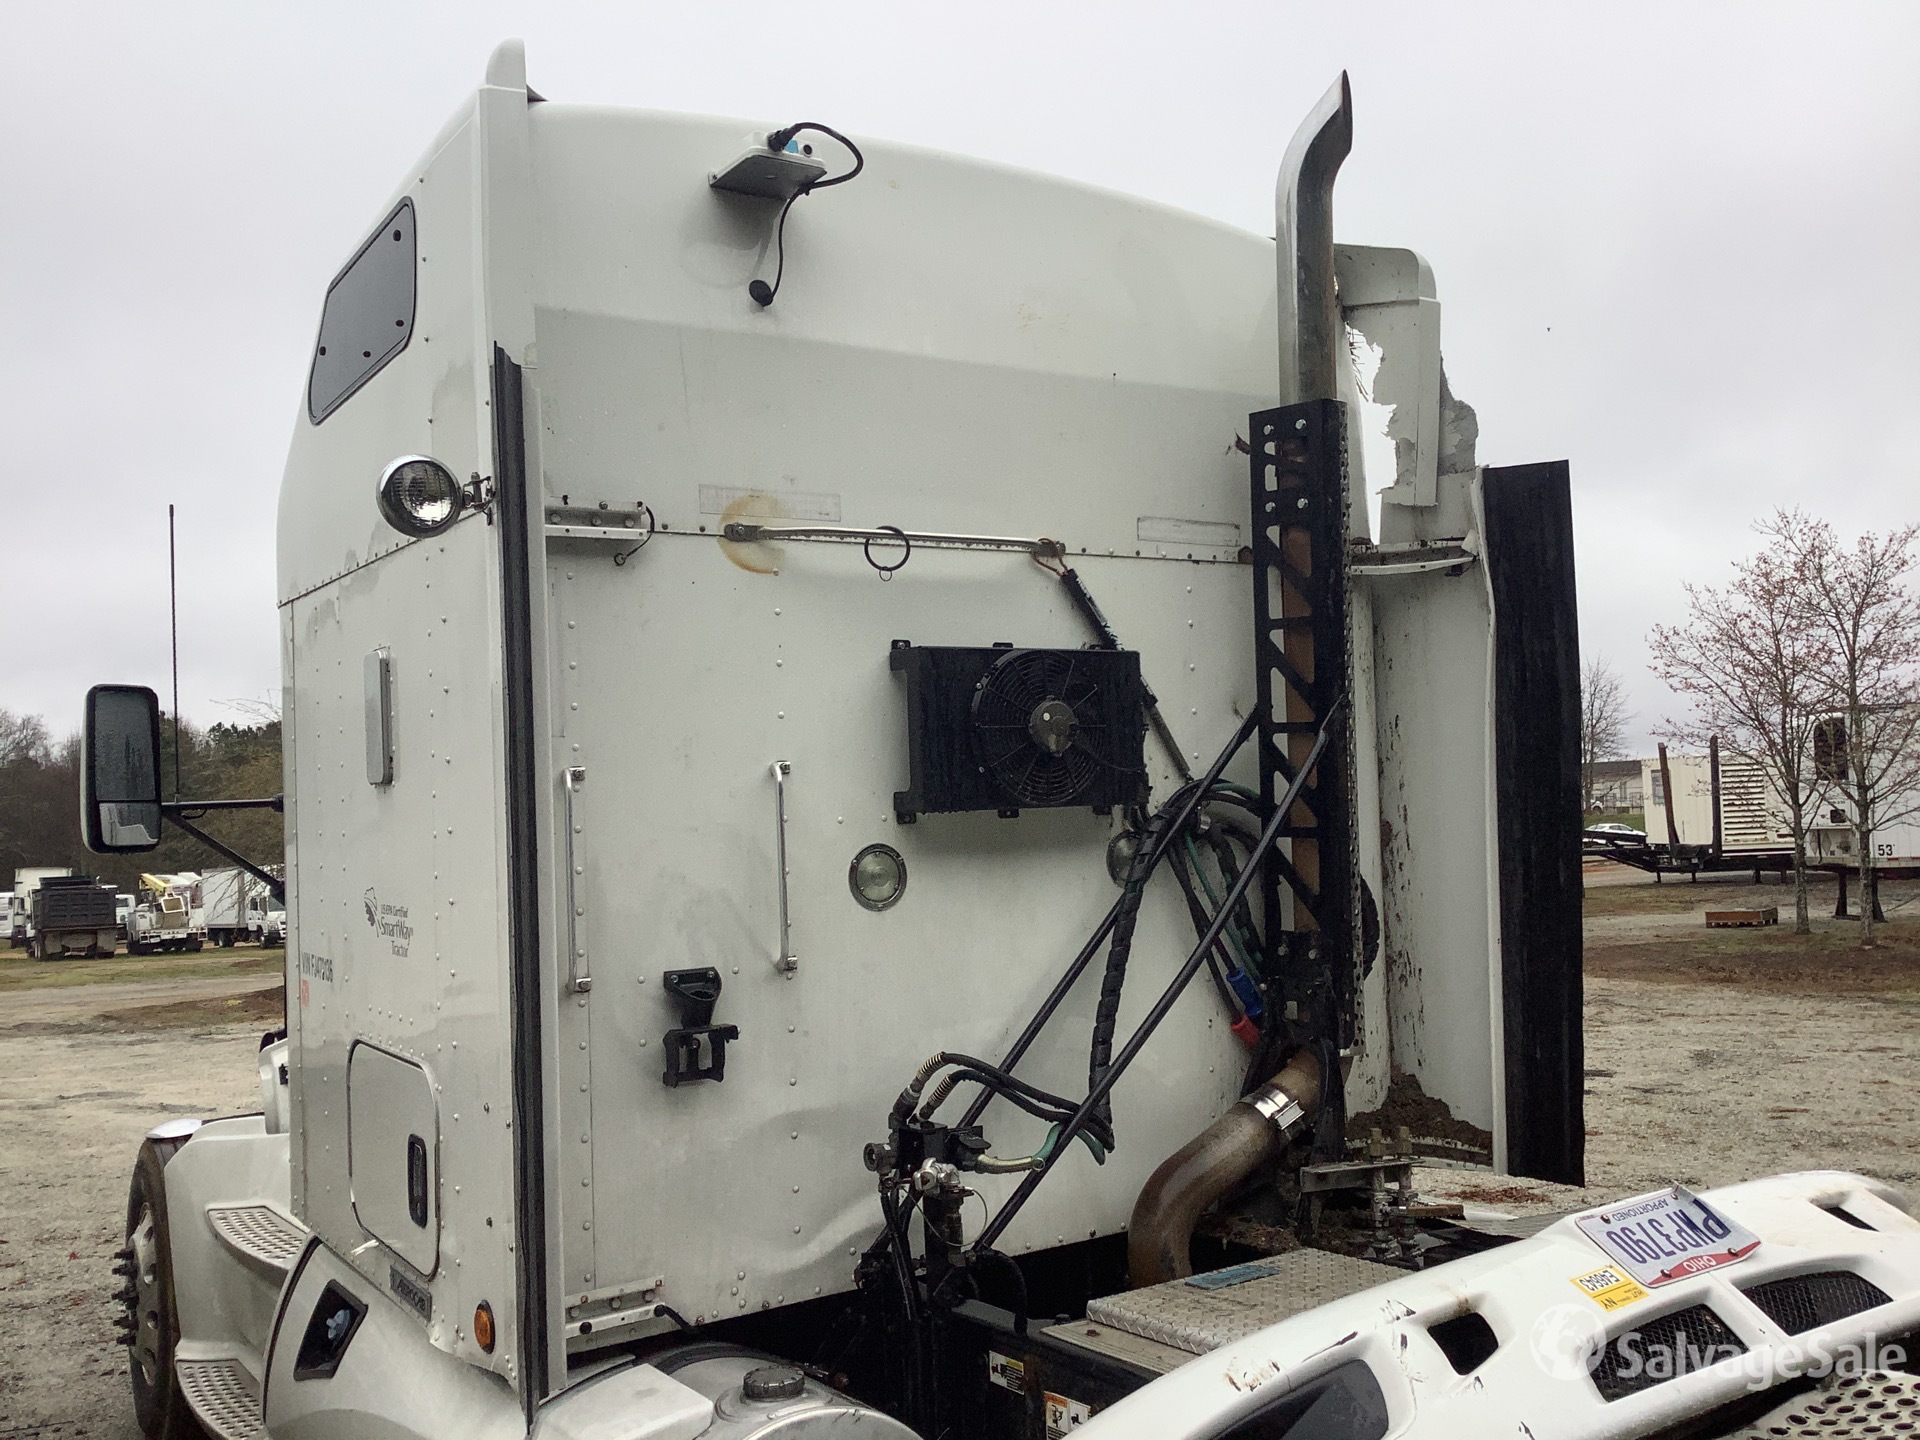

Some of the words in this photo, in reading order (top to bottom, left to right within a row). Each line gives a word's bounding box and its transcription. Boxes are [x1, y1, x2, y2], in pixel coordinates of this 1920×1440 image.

[1611, 1198, 1669, 1222] APPORTIONED
[1606, 1198, 1731, 1264] PWP3790
[1682, 1255, 1716, 1272] OHIO
[1600, 1297, 1618, 1310] NY
